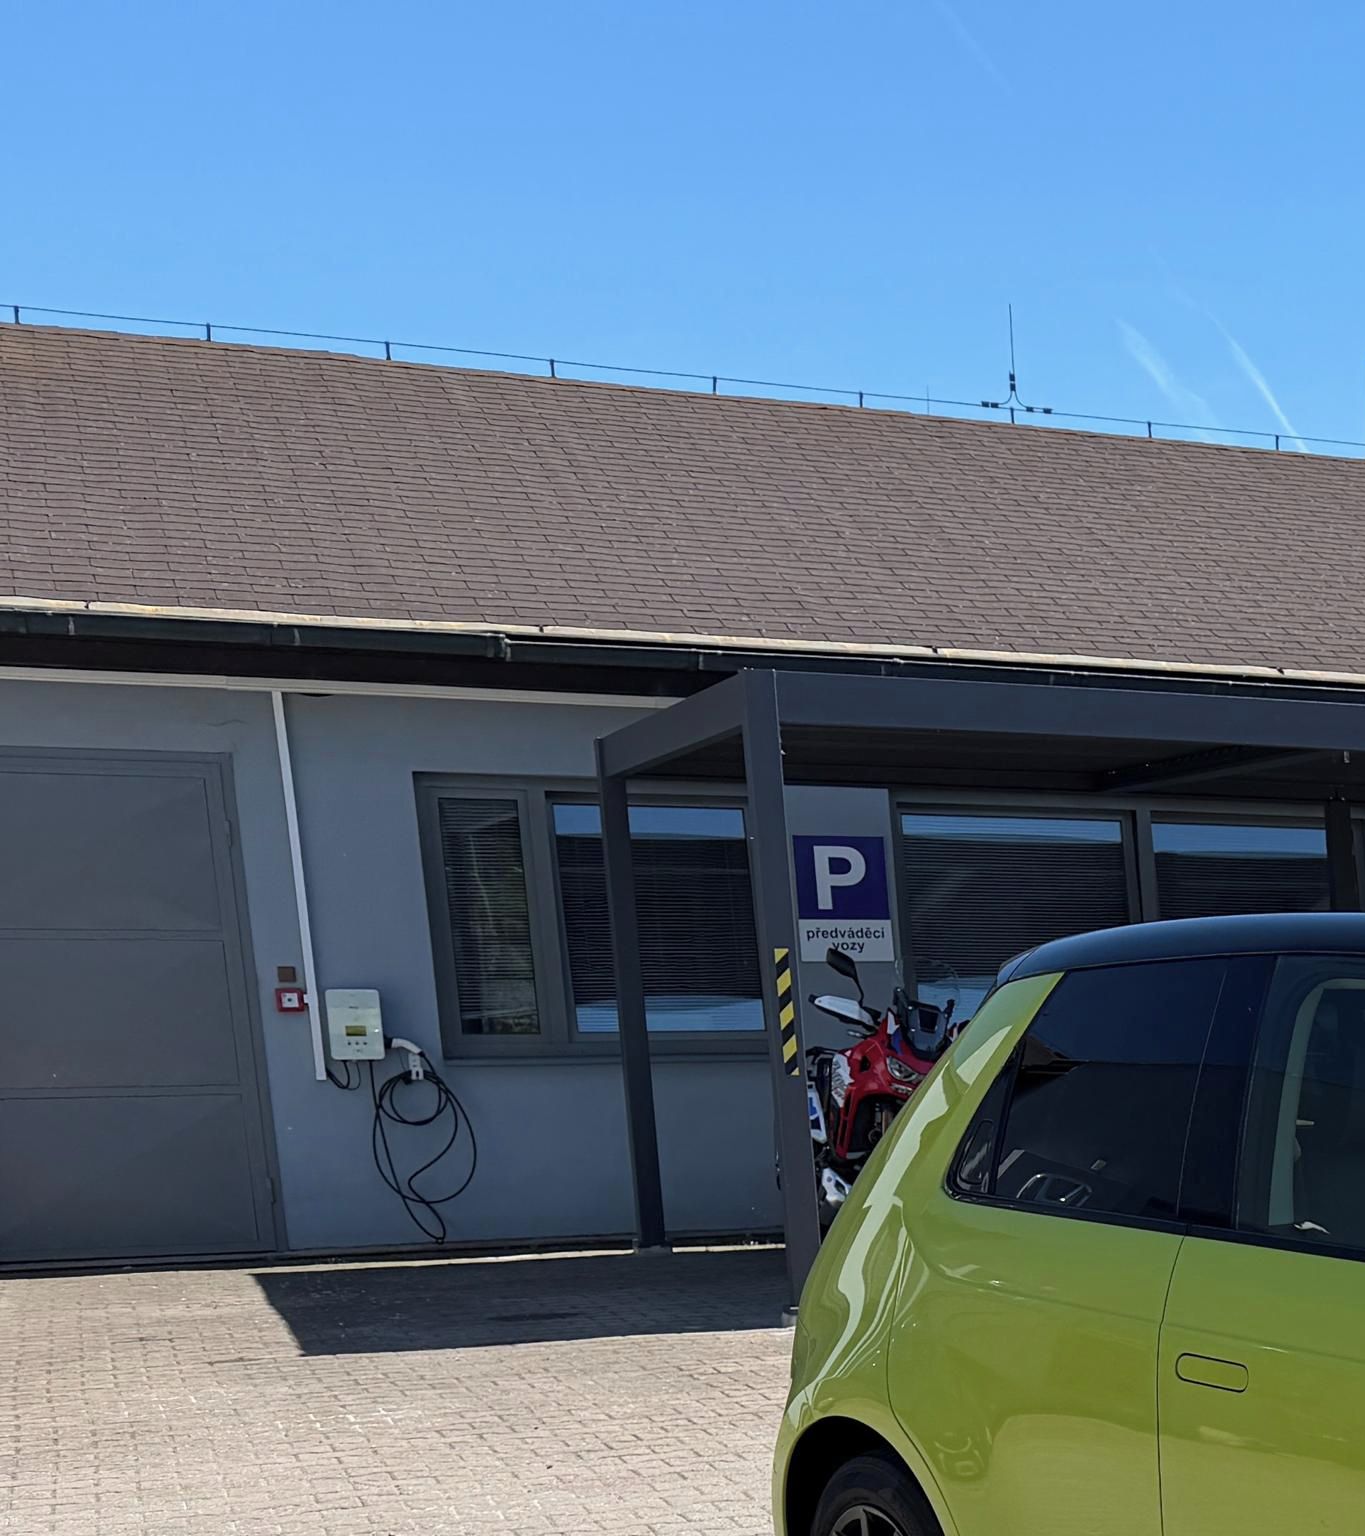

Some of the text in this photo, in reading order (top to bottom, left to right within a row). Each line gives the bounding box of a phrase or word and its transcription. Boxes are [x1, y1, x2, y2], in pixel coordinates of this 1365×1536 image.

[813, 845, 867, 910] P
[806, 926, 885, 941] předváděcí
[831, 942, 865, 953] vozy
